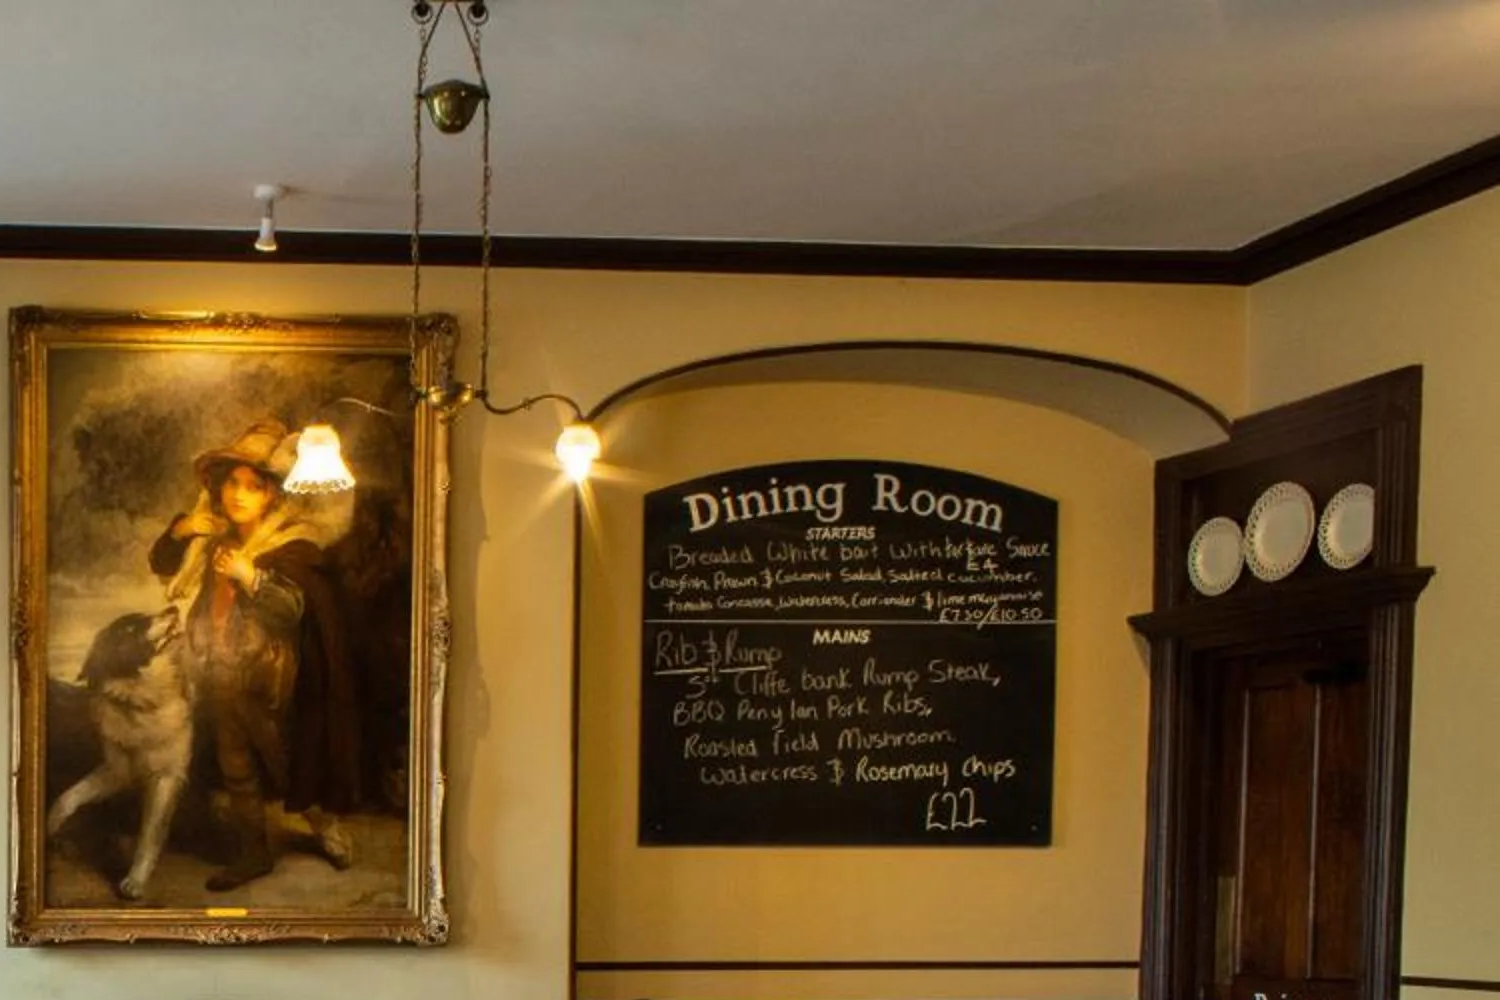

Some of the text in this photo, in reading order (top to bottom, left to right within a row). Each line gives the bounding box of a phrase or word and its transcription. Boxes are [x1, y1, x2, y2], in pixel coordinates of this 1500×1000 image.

[683, 473, 1003, 532] Dining Room
[805, 527, 876, 541] STARTERS
[668, 544, 754, 570] Breaded
[654, 630, 699, 668] Rib
[725, 628, 782, 670] Rump
[812, 629, 872, 645] MAINS
[863, 657, 919, 691] Rump
[673, 701, 726, 727] BBQ
[826, 694, 870, 719] Pork
[684, 733, 759, 759] Roasted
[856, 755, 948, 787] Rosemary
[925, 787, 988, 831] £22
